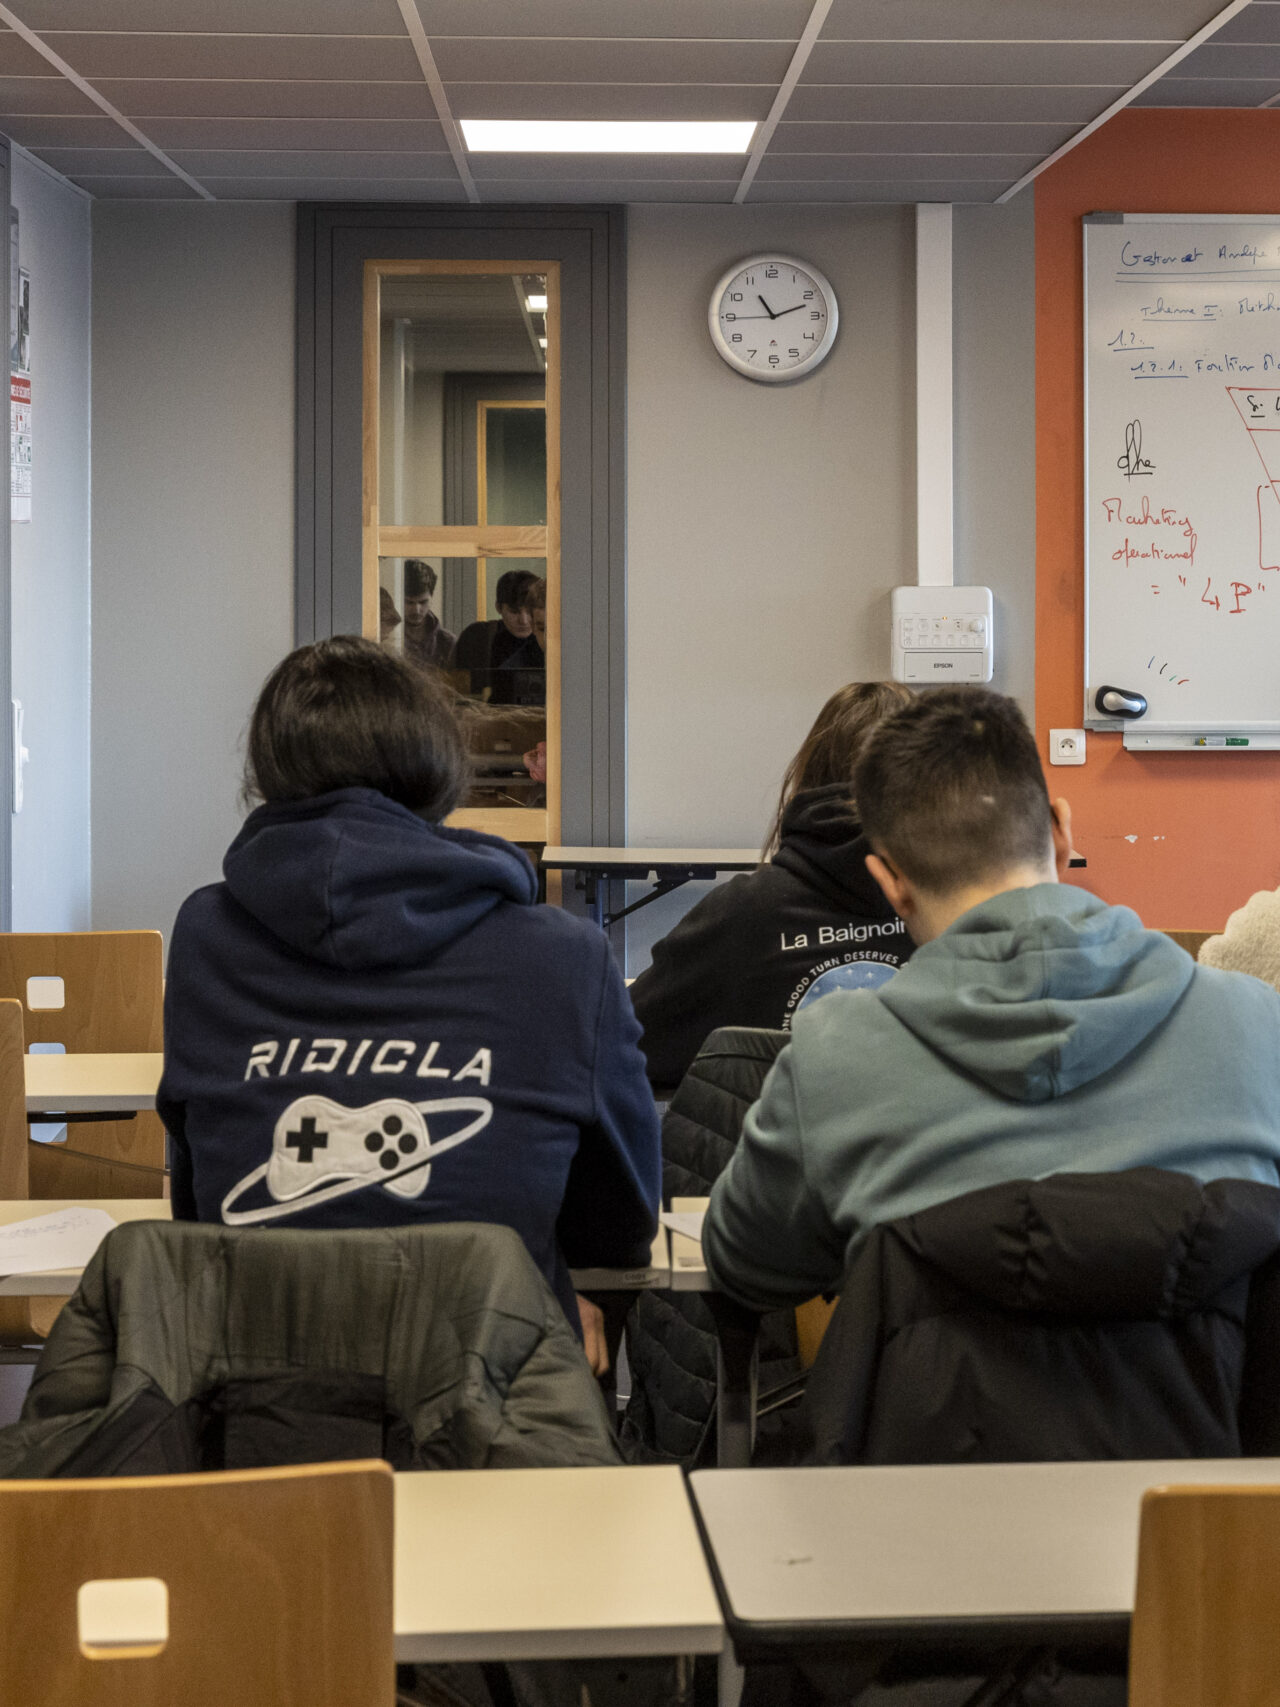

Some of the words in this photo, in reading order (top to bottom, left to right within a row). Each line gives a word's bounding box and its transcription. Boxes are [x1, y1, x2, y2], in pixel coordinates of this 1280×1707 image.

[765, 269, 779, 279] 12
[746, 276, 755, 285] 11
[730, 292, 744, 302] 10
[803, 290, 814, 300] 2
[725, 313, 737, 322] 9
[810, 311, 821, 321] 3
[731, 333, 743, 343] 8
[803, 332, 815, 341] 4
[747, 349, 757, 359] 7
[788, 348, 800, 358] 5
[768, 355, 780, 364] 6
[780, 932, 809, 951] La
[818, 917, 906, 944] Baignoir
[786, 977, 810, 1008] GOOD
[809, 957, 841, 977] TURN
[844, 950, 900, 965] DESERVES
[244, 1037, 492, 1087] RIDICLA
